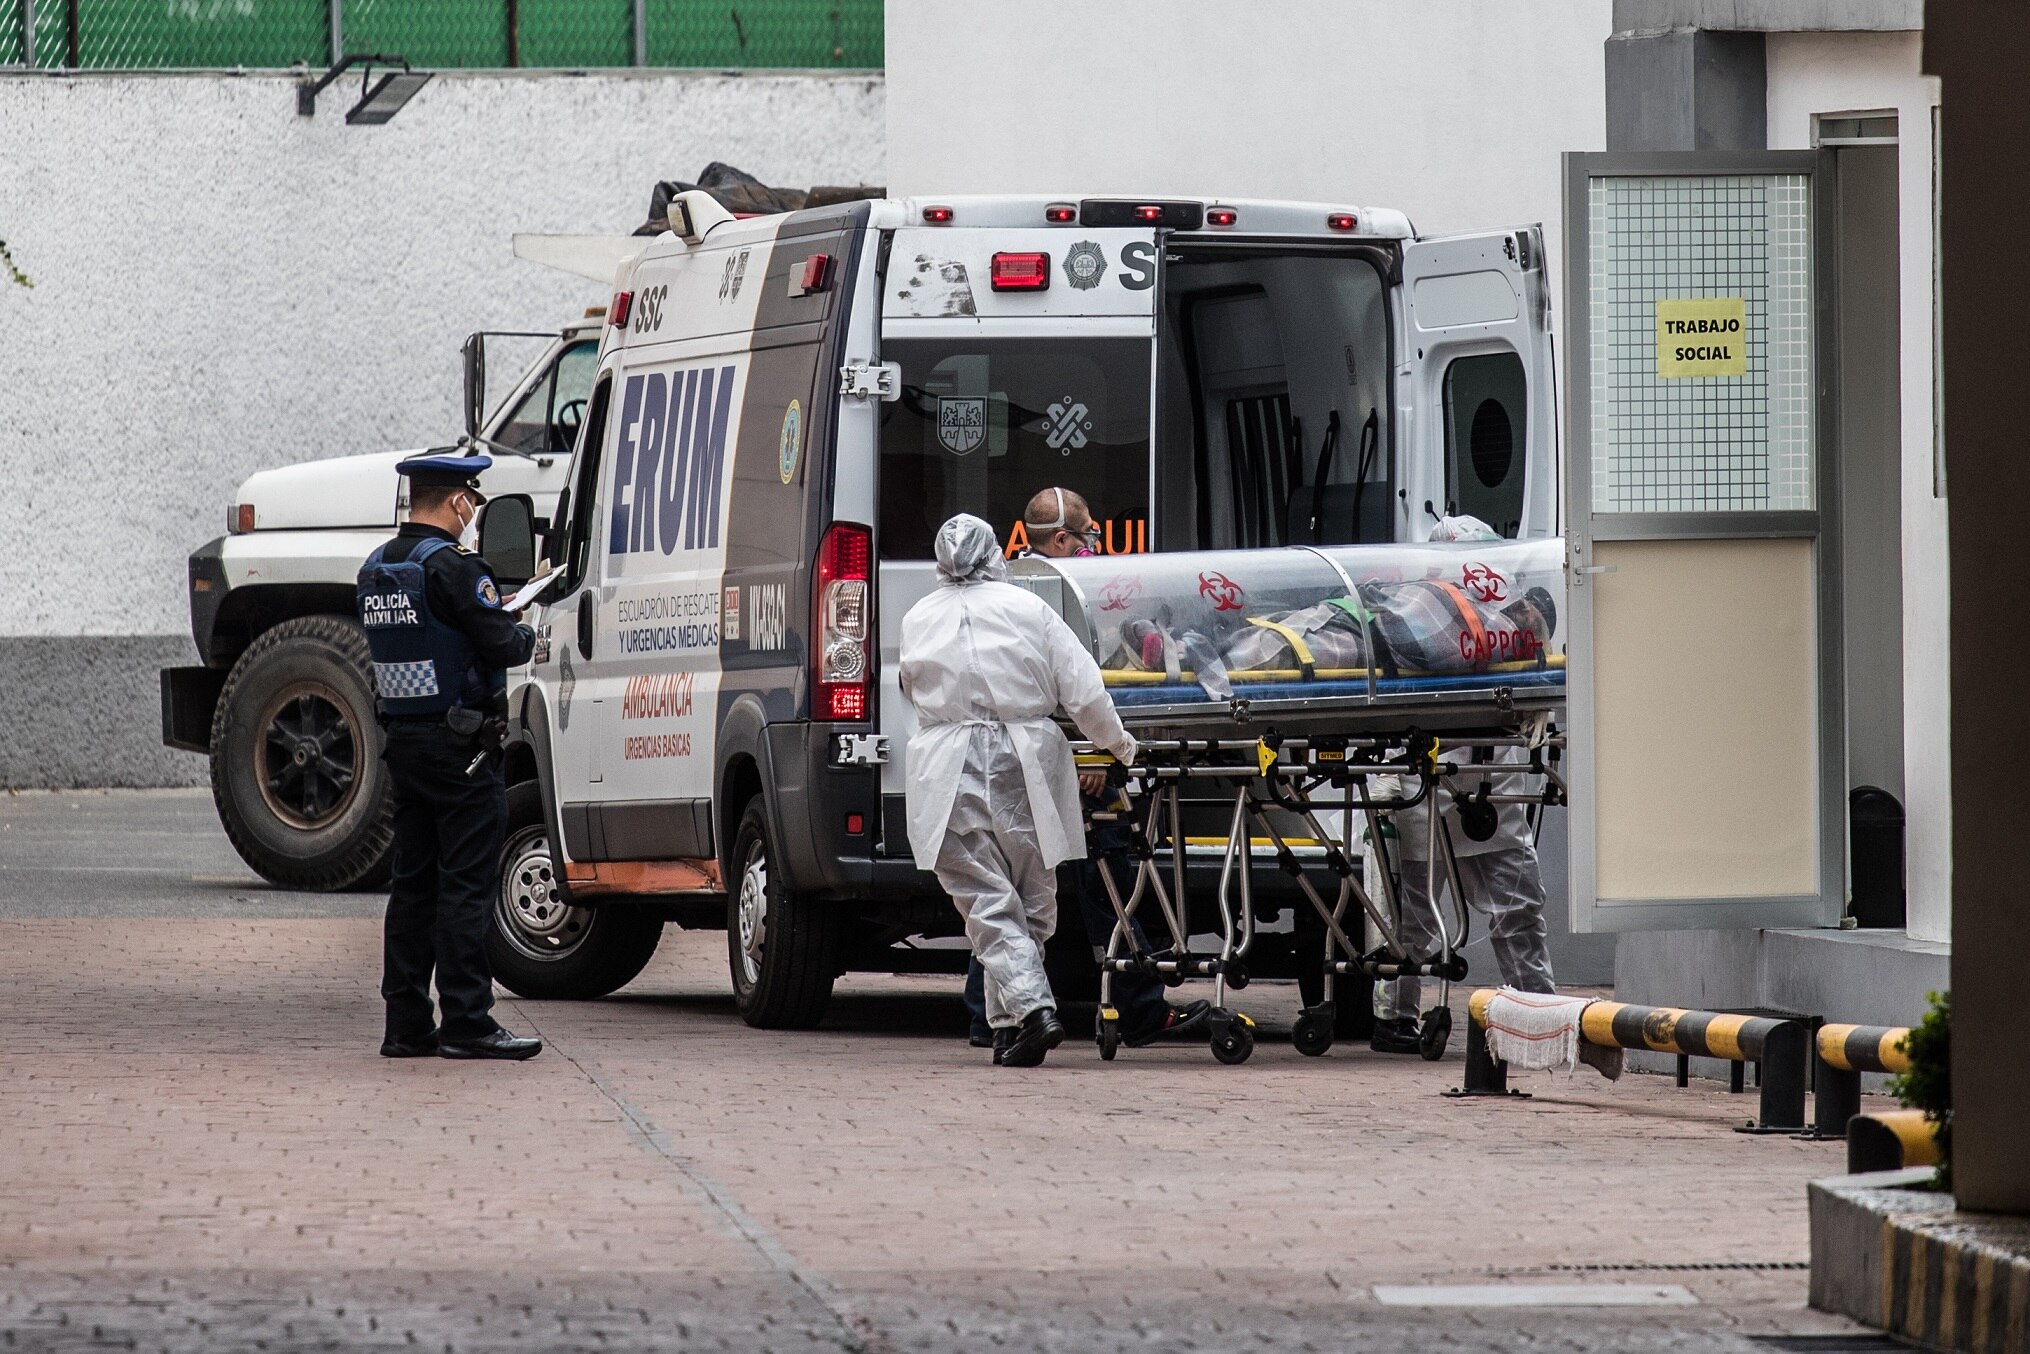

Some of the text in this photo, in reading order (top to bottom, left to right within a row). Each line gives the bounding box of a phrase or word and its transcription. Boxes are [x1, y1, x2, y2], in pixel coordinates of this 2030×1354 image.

[635, 285, 667, 334] SSC
[1665, 319, 1740, 334] TRABAJO
[1676, 346, 1732, 361] SOCIAL
[609, 366, 736, 556] ERUM
[364, 589, 411, 611] POLICÍA
[618, 592, 719, 622] ESCUADRÓN DE RESCATE
[363, 609, 419, 627] AUXILIAR
[618, 618, 719, 653] Y URGENCIAS MÉDICAS
[622, 671, 694, 720] AMBULANCIA
[624, 732, 691, 760] URGENCIAS BASICAS
